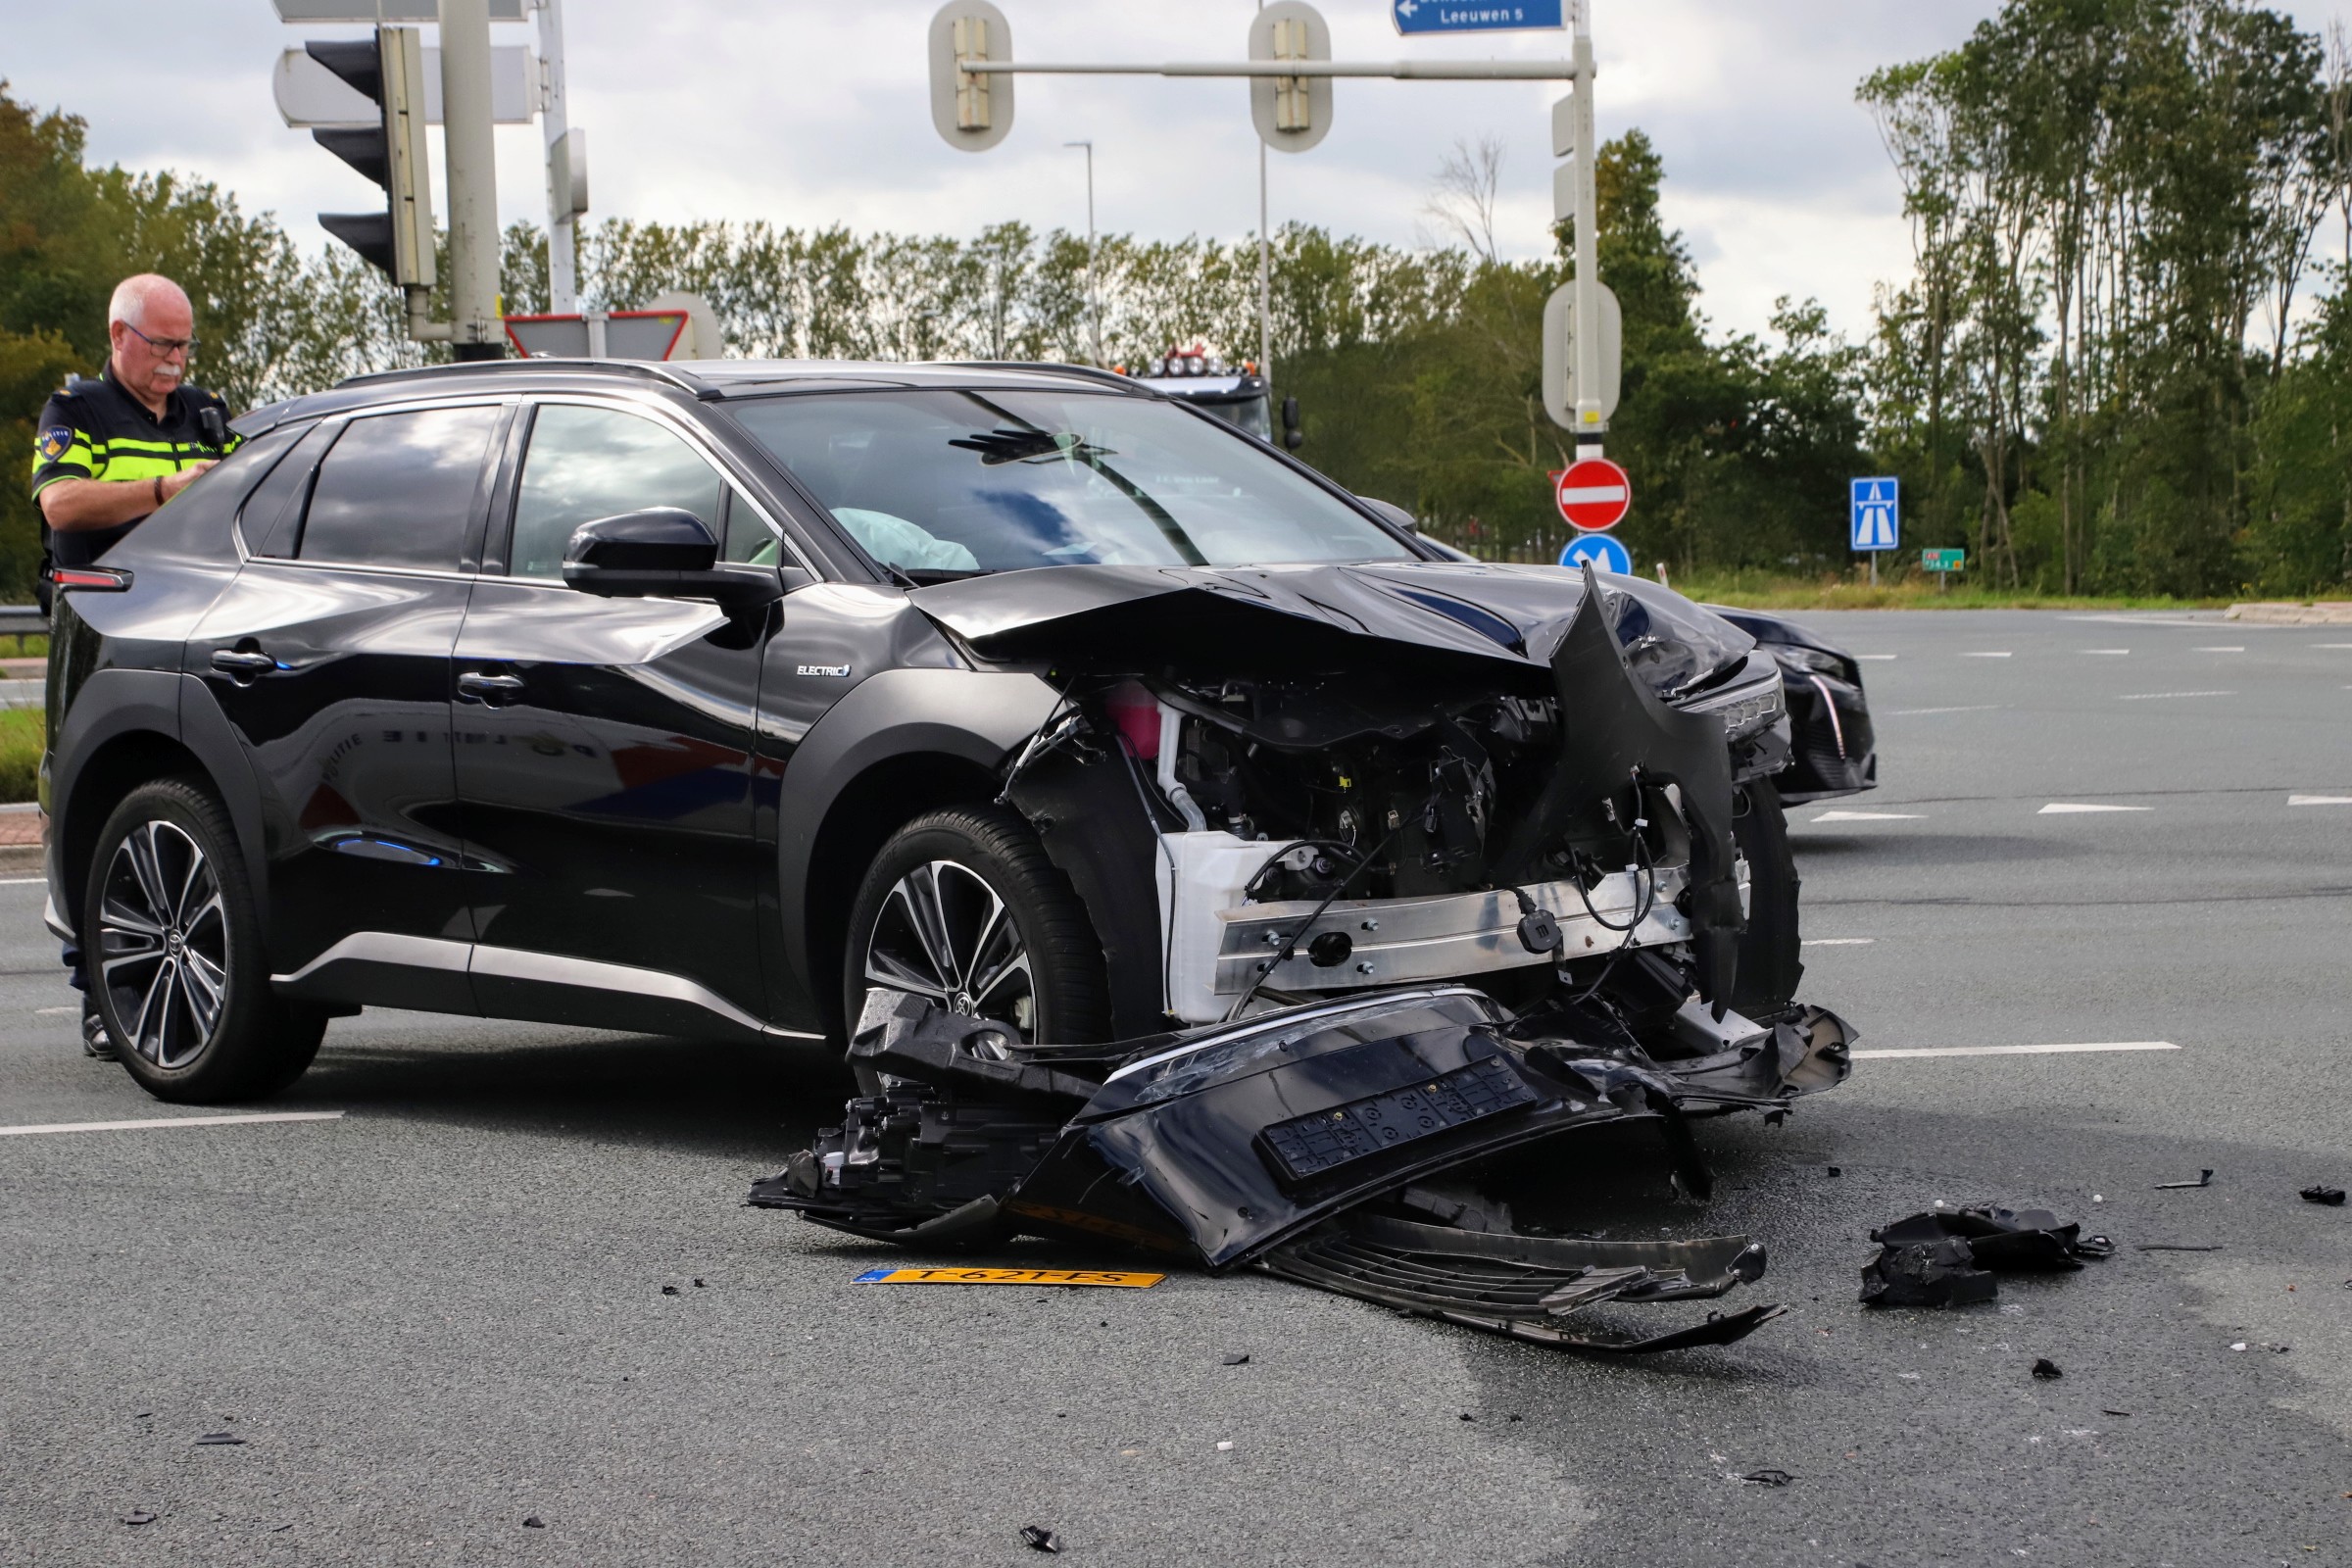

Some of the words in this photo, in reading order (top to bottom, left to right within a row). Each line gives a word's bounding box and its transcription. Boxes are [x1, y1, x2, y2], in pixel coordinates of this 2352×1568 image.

[1441, 9, 1510, 24] Leeuwen
[797, 665, 844, 676] ELECTRIC
[916, 1270, 1129, 1285] T-621-FS
